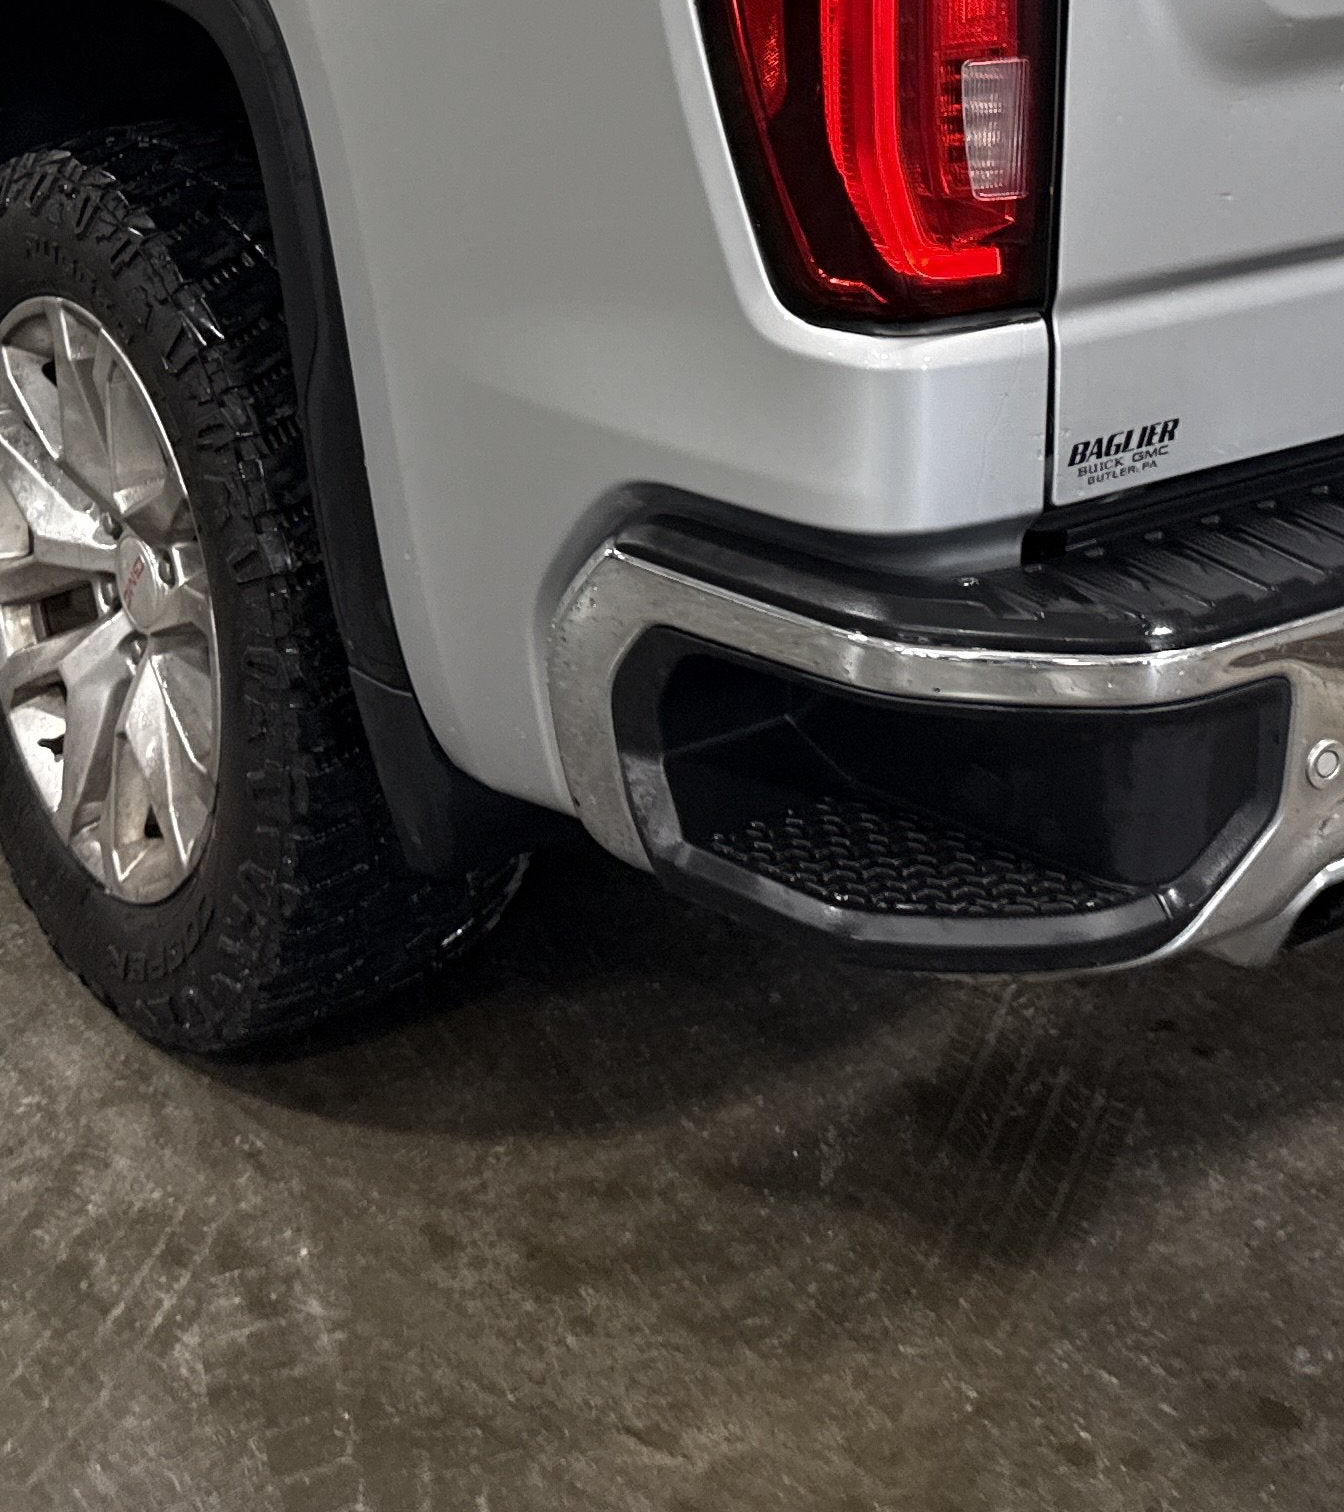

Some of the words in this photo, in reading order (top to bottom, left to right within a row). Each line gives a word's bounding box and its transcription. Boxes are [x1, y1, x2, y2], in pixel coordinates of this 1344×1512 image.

[1067, 417, 1180, 467] BAGLIER
[1077, 456, 1124, 478] BUICK
[1131, 444, 1169, 463] GMC
[1142, 459, 1157, 471] PA
